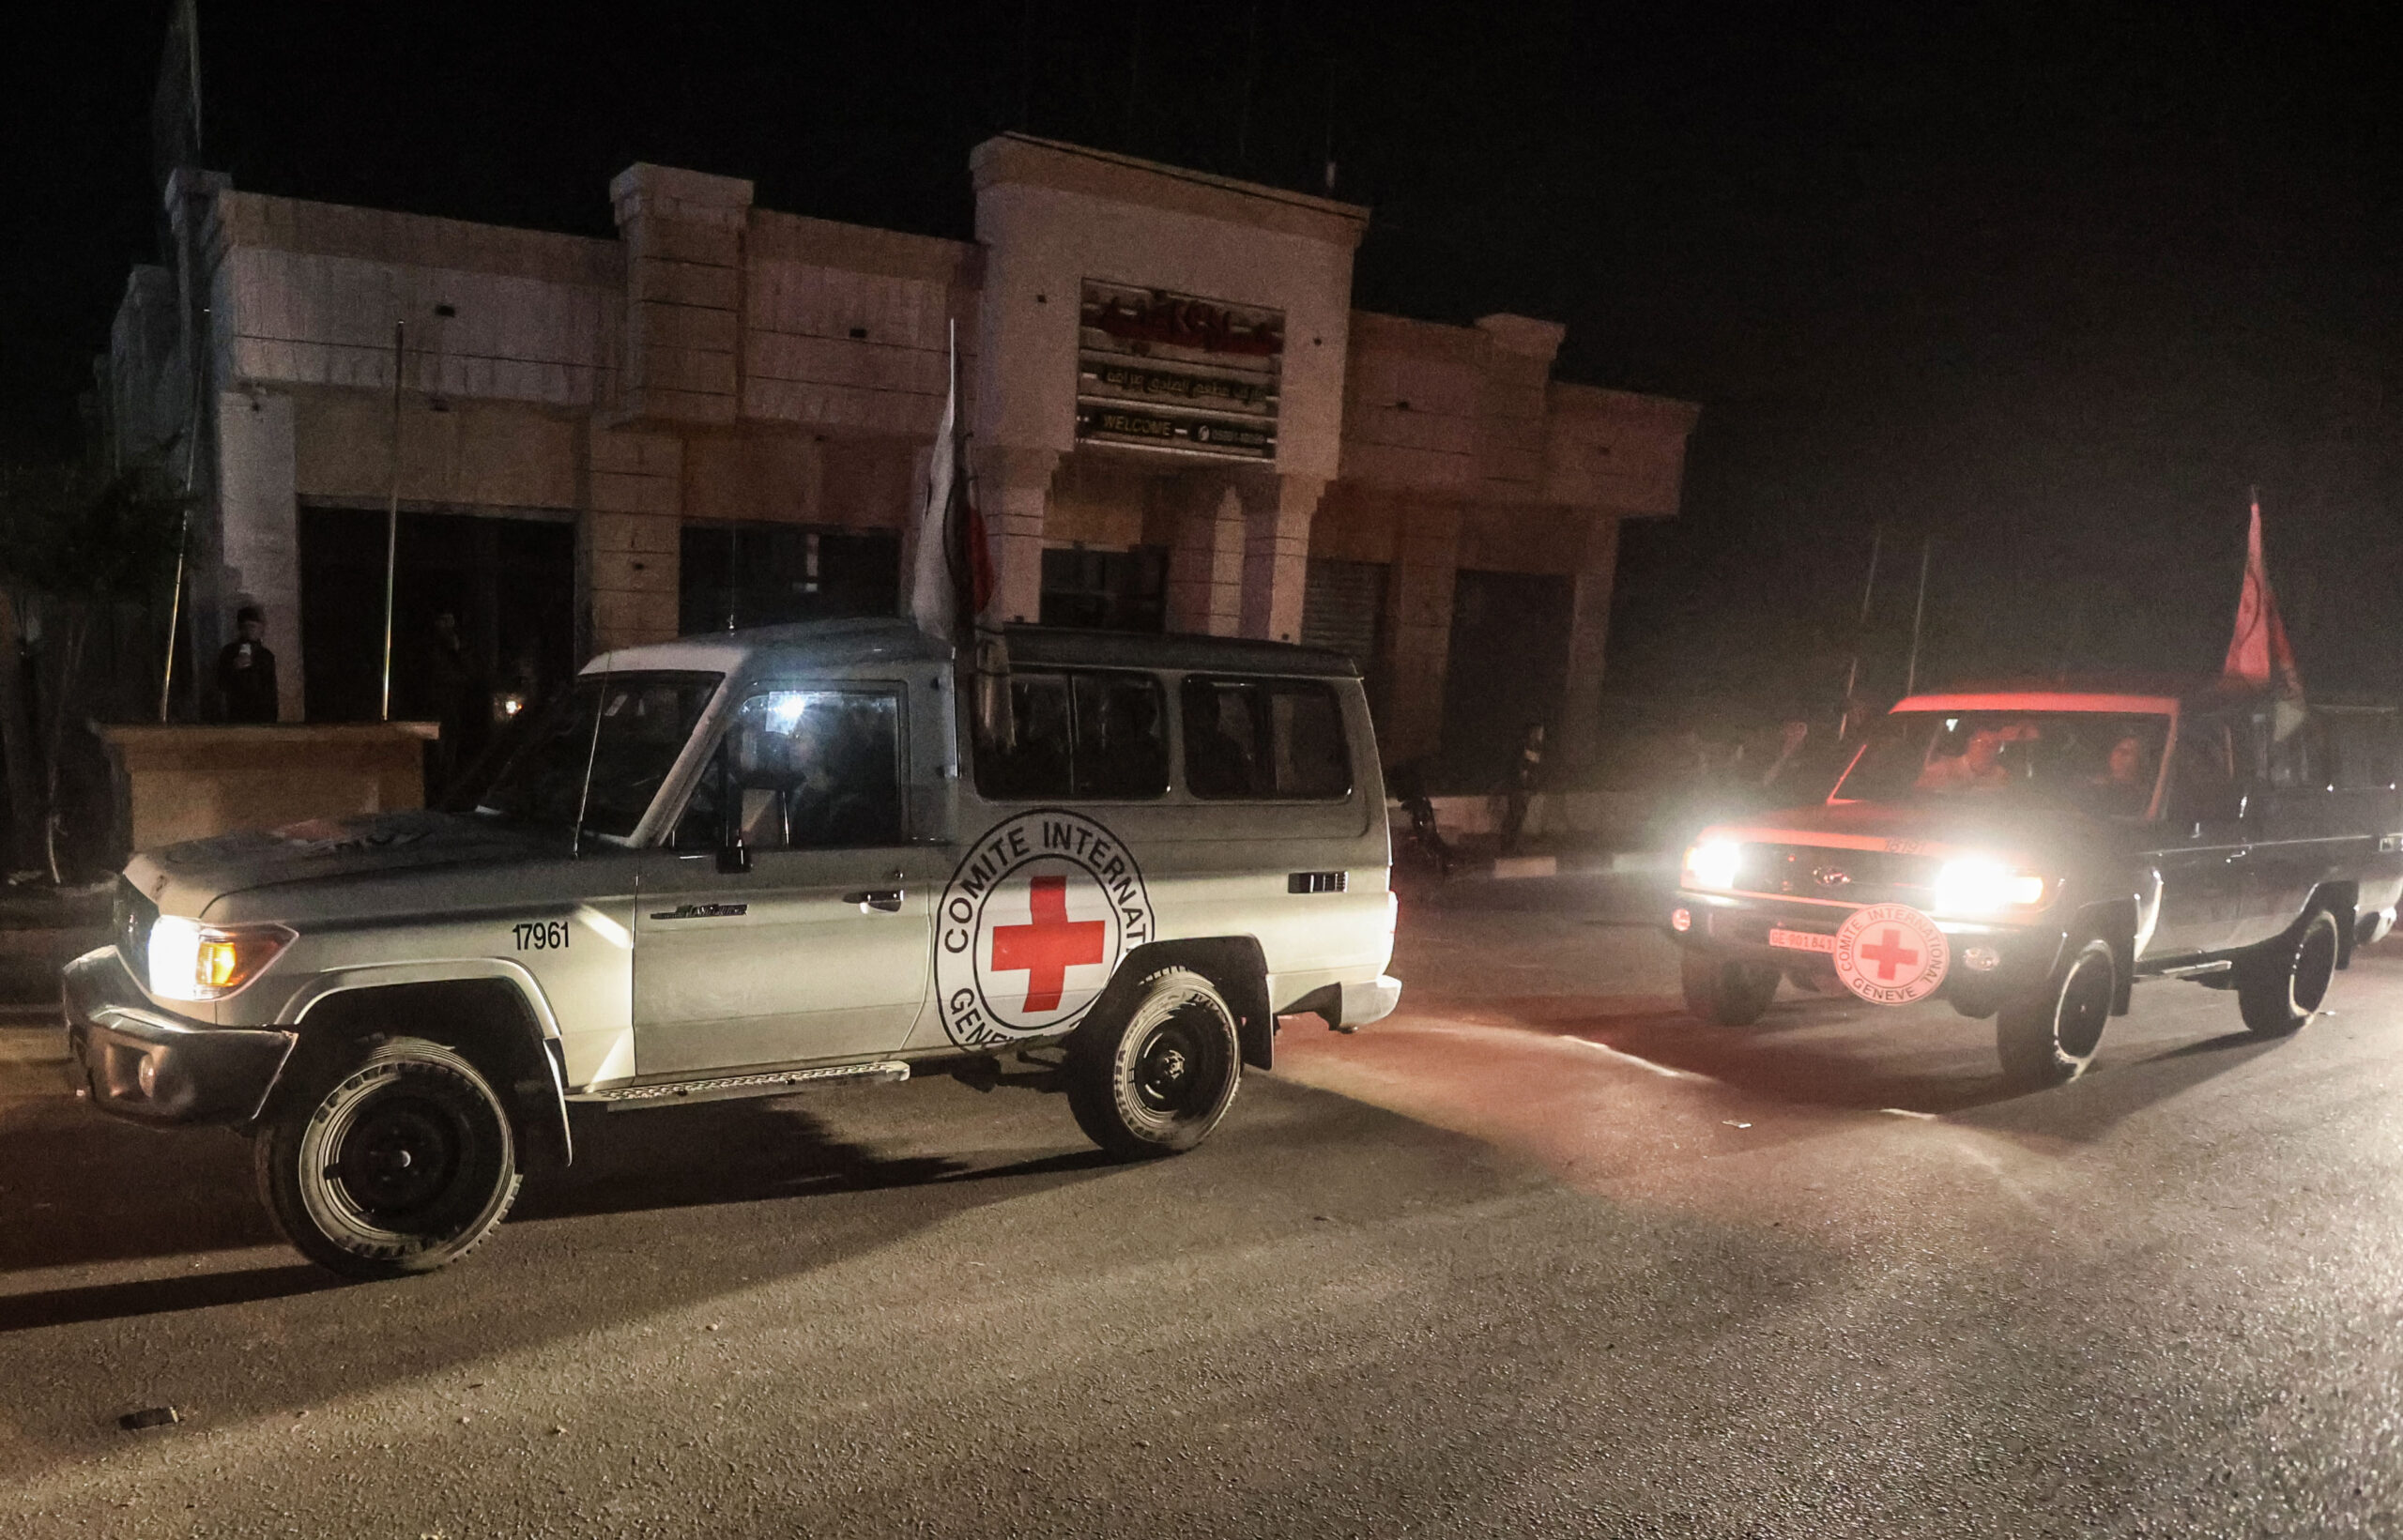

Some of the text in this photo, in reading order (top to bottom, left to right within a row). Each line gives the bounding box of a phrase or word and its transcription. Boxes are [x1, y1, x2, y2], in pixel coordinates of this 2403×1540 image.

[1104, 415, 1172, 436] WELCOME
[944, 821, 1147, 953] COMITE INTERNAT
[512, 921, 570, 951] 17961
[1839, 907, 1943, 984] COMITE INTERNATIONAL
[1852, 978, 1917, 1001] GENEVE
